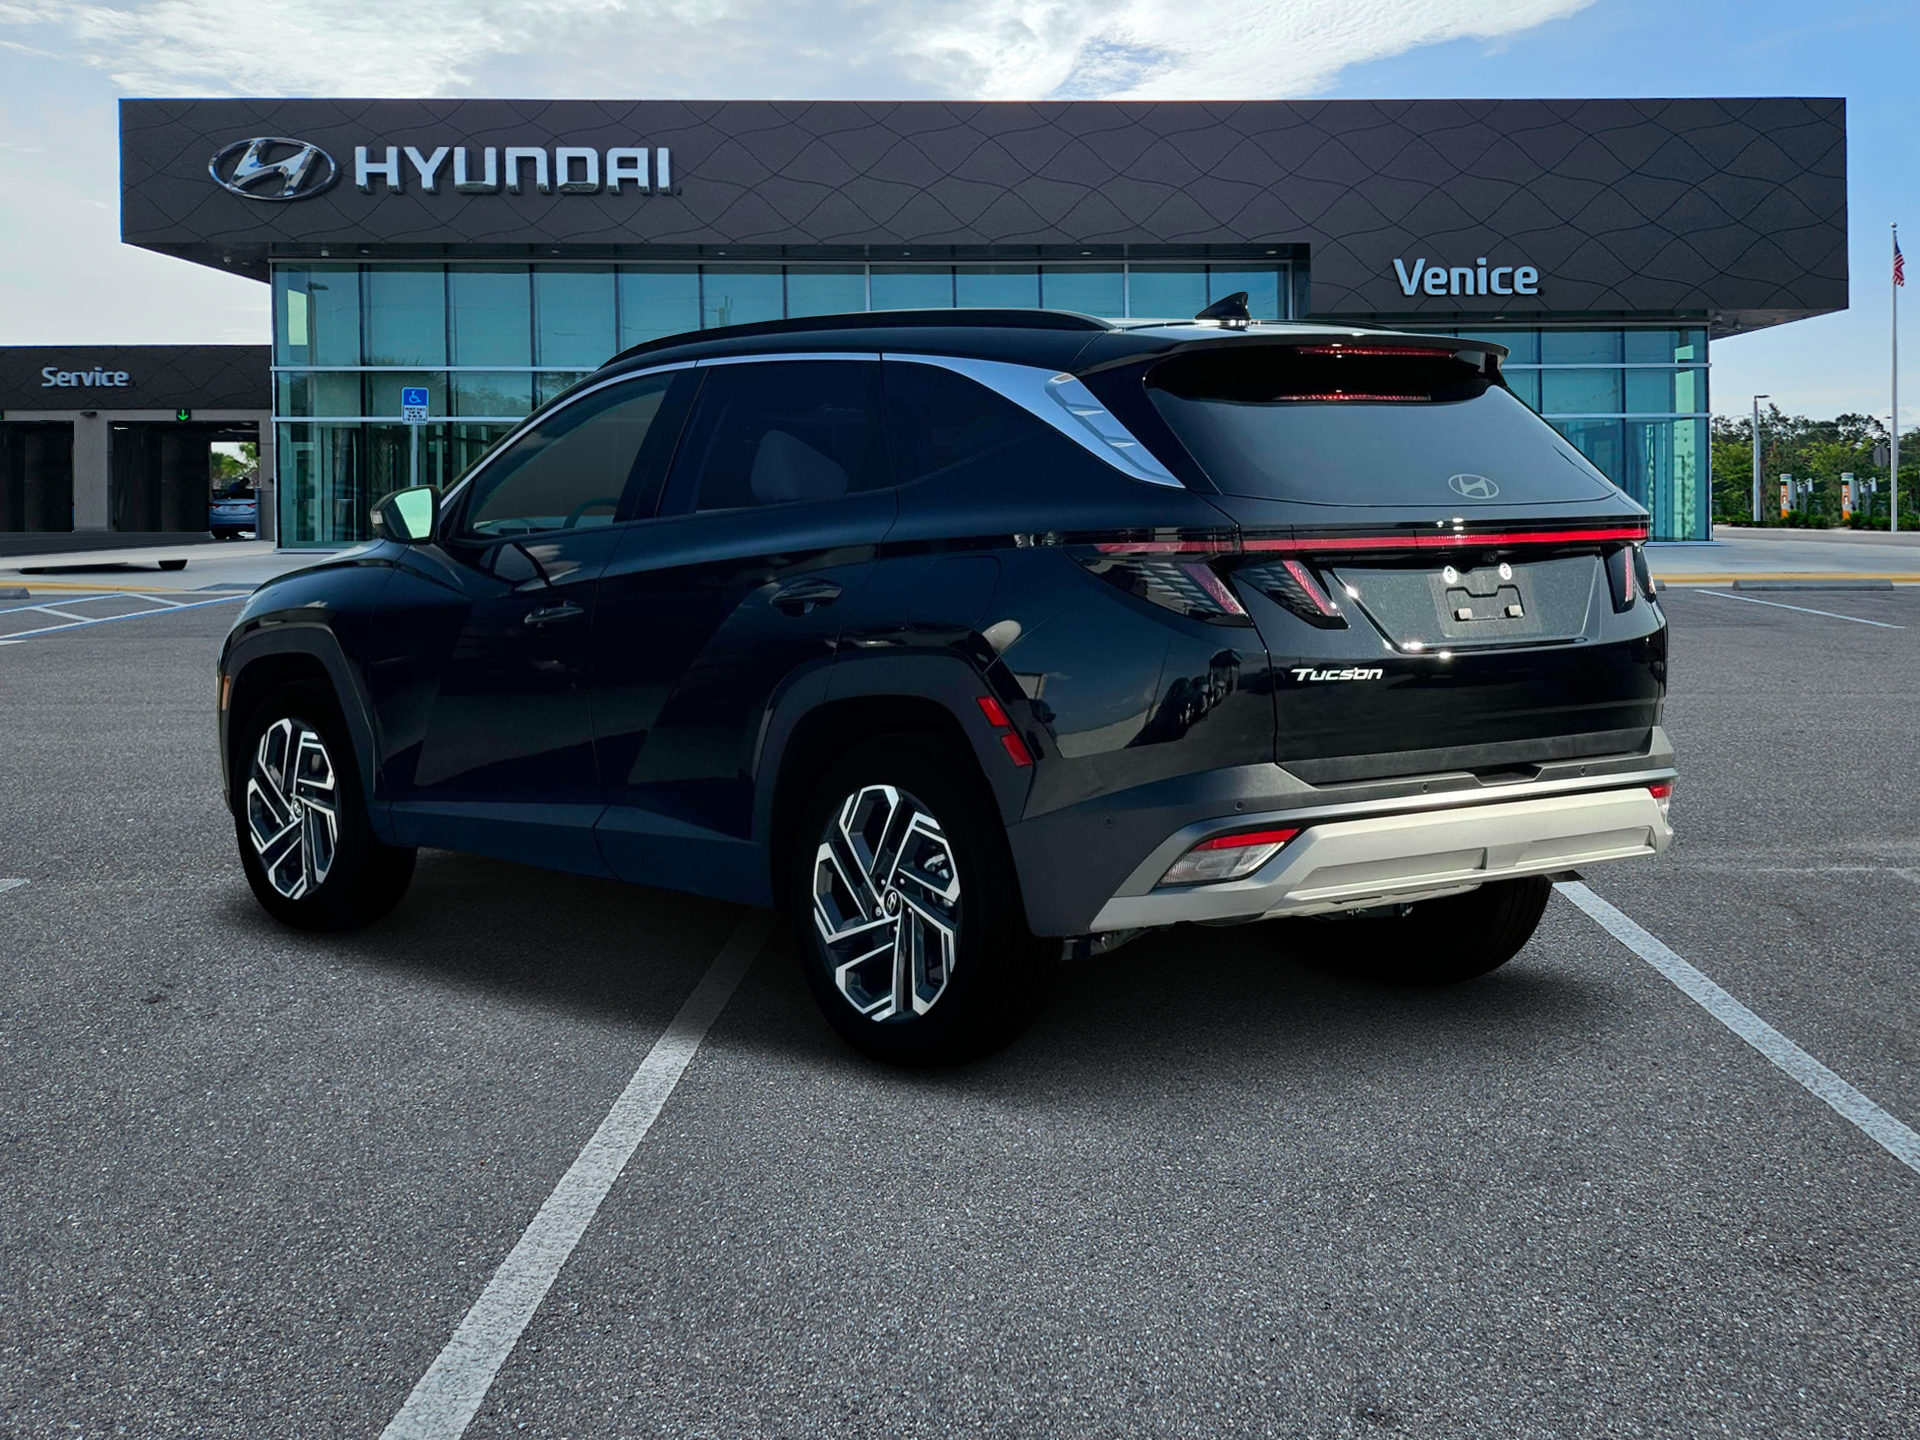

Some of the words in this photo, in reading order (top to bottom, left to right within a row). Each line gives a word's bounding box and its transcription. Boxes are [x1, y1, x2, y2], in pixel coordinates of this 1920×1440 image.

[354, 146, 671, 194] HYUNDAI
[1393, 257, 1538, 295] Venice
[41, 366, 130, 387] Service
[1290, 667, 1383, 681] Tucson
